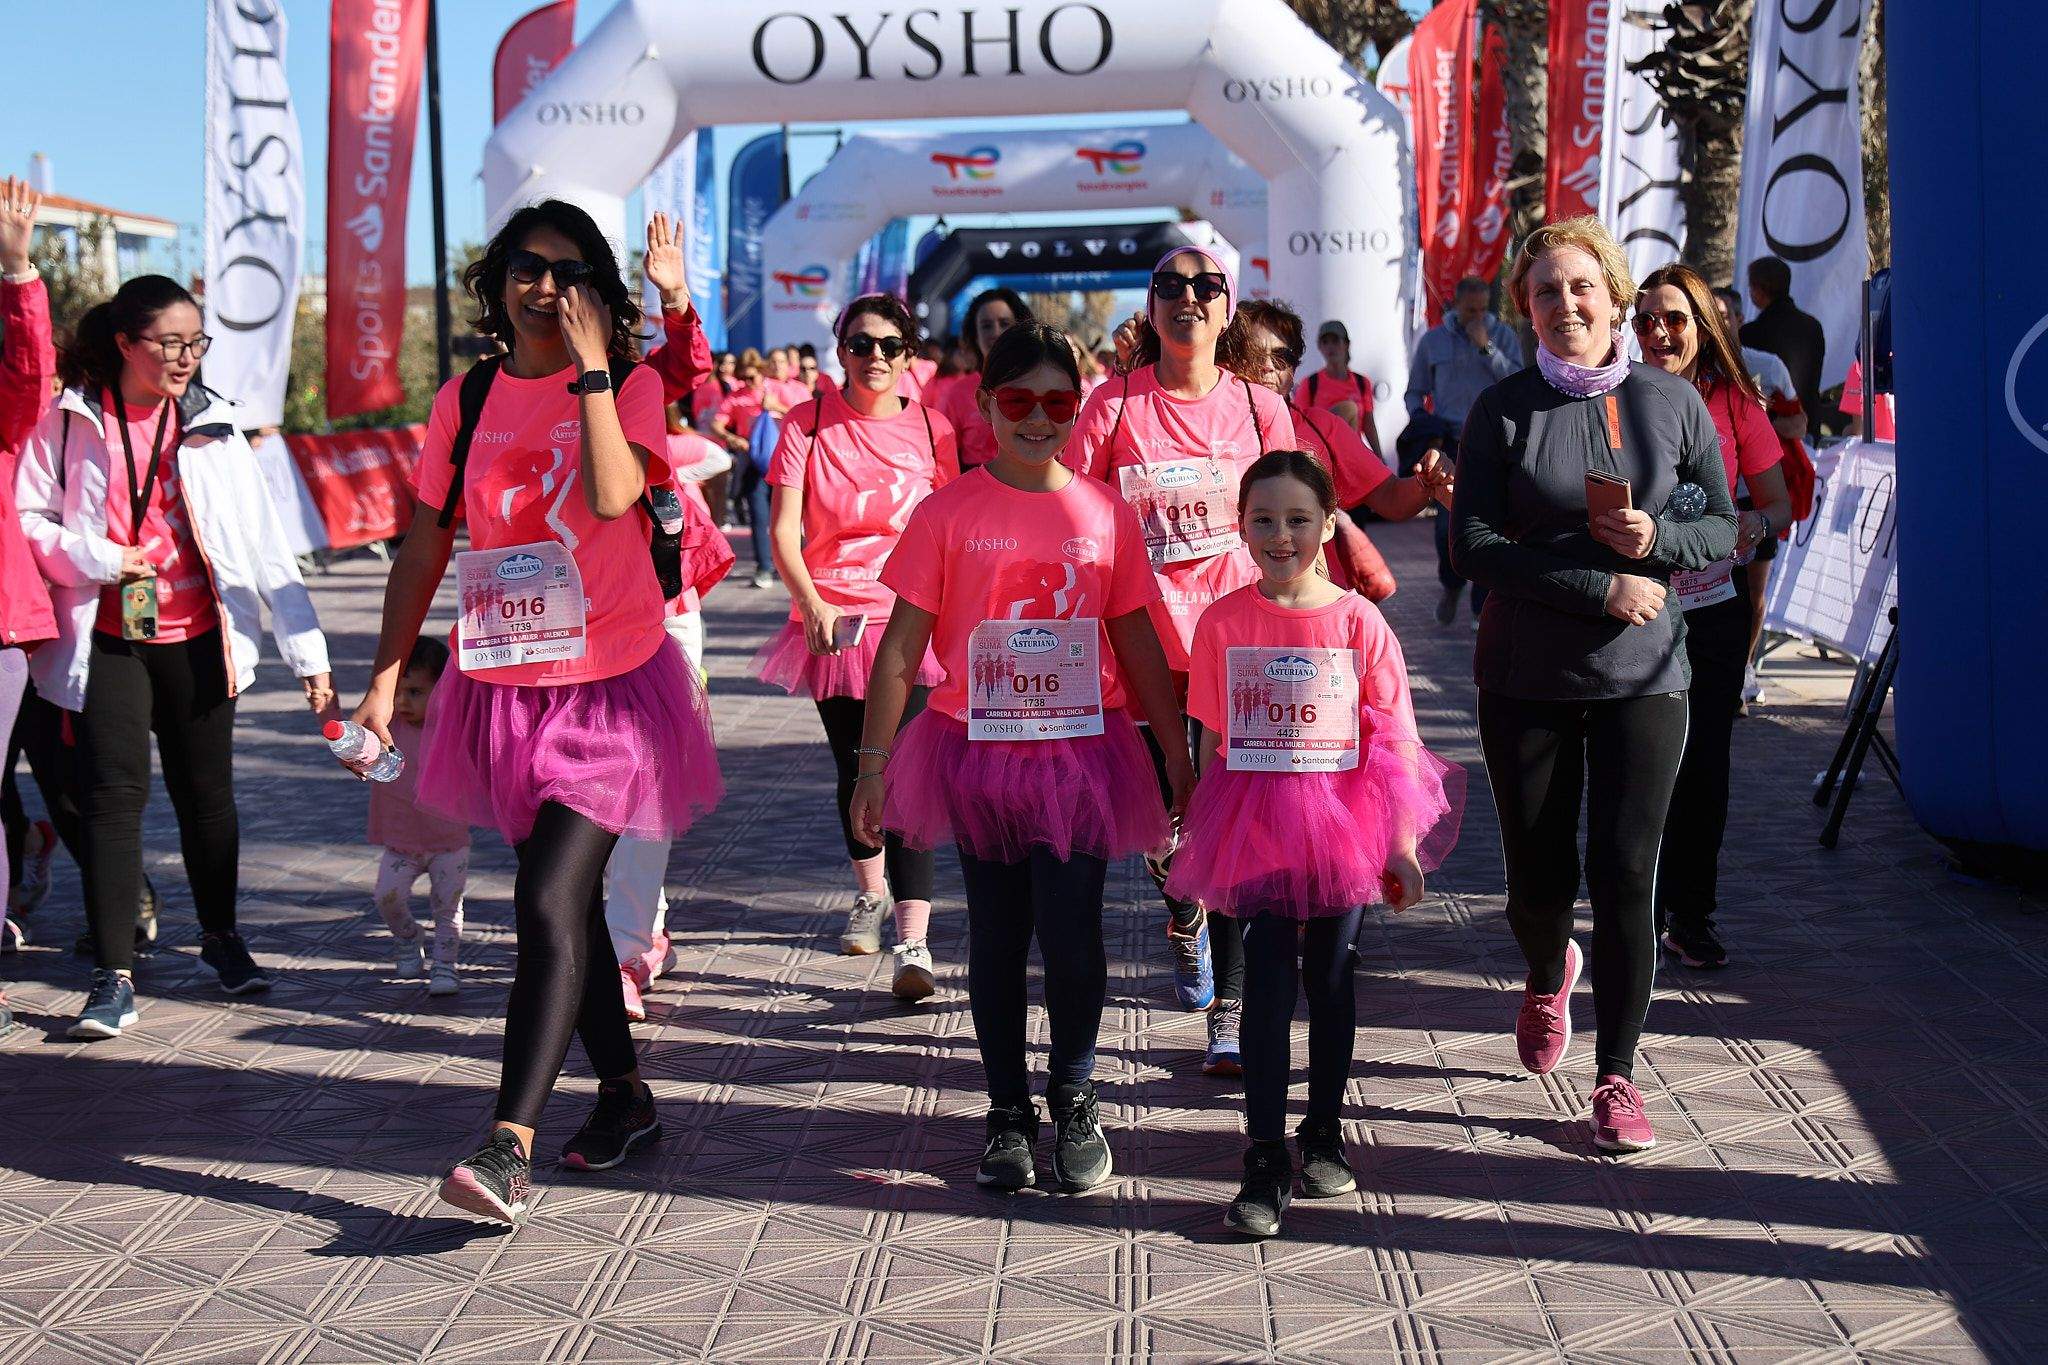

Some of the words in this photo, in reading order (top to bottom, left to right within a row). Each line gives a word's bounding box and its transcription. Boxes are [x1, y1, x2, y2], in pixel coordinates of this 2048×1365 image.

[753, 3, 1113, 85] OYSHO
[1223, 78, 1332, 103] OYSHO
[536, 102, 645, 126] OYSHO
[1288, 230, 1390, 256] OYSHO
[986, 238, 1138, 260] VOLVO
[351, 257, 392, 381] Sports
[1160, 474, 1200, 485] ASTURIANA
[1166, 501, 1208, 521] 016
[965, 538, 1018, 552] OYSHO
[500, 563, 541, 576] ASTURIANA
[501, 597, 545, 619] 016
[510, 622, 532, 632] 1739
[543, 630, 570, 639] VALENCIA
[978, 642, 1002, 650] SUMA
[1011, 638, 1056, 648] ASTURIANA
[535, 644, 573, 655] Santander
[475, 649, 512, 662] OYSHO
[1237, 669, 1259, 677] SUMA
[1268, 666, 1314, 676] ASTURIANA
[1013, 673, 1060, 693] 016
[1022, 698, 1046, 708] 1738
[985, 710, 1012, 718] CARRERA
[1013, 710, 1021, 718] DE
[1031, 709, 1051, 717] MUJER
[1056, 708, 1085, 716] VALENCIA
[1268, 703, 1317, 723] 016
[983, 723, 1024, 733] OYSHO
[1048, 722, 1088, 732] Santander
[1276, 728, 1300, 738] 4423
[1268, 740, 1276, 748] DE
[1276, 740, 1284, 748] LA
[1240, 753, 1277, 764] OYSHO
[1301, 756, 1343, 765] Santander
